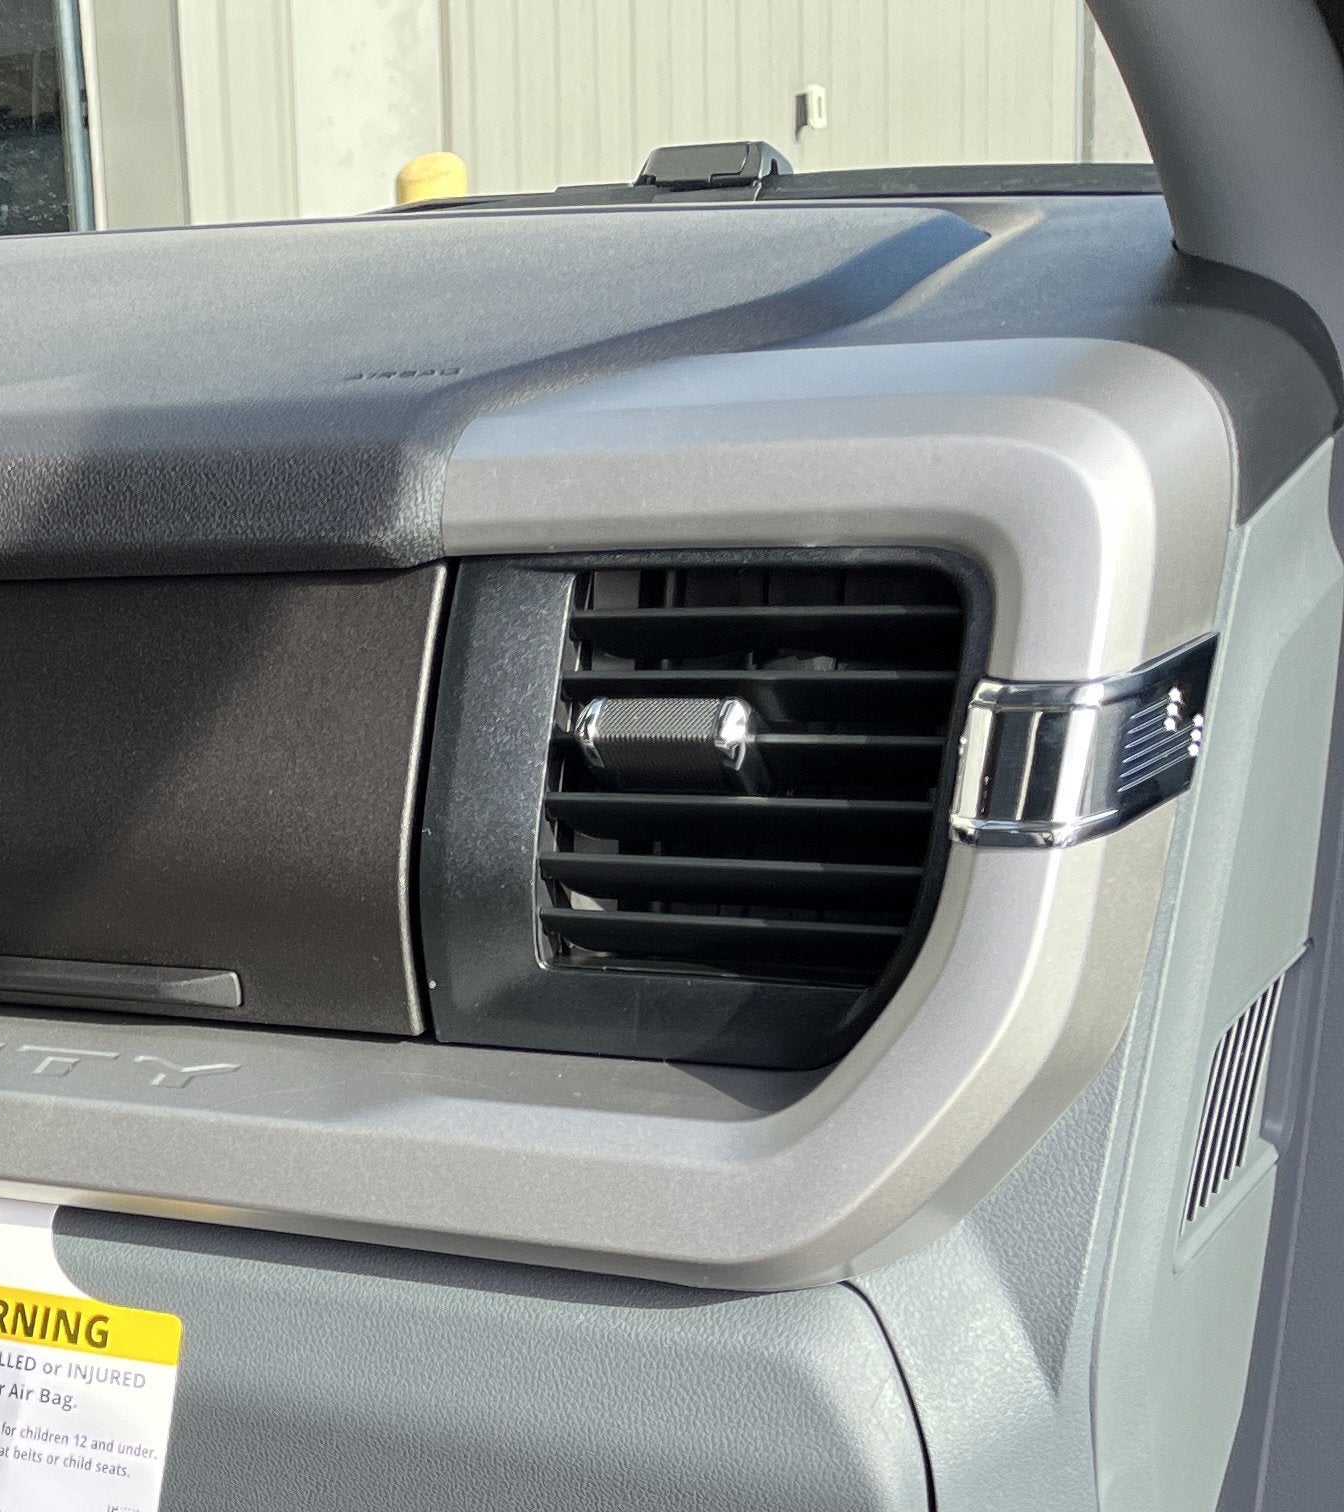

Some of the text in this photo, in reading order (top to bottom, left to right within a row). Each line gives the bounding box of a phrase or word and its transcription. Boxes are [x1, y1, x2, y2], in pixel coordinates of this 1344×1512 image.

[42, 1362, 62, 1376] or
[67, 1362, 146, 1389] INJURED
[8, 1383, 34, 1401] Air
[39, 1388, 79, 1412] Bag.
[1, 1421, 17, 1437] for
[19, 1425, 69, 1446] children
[73, 1433, 88, 1449] 12
[90, 1439, 114, 1453] and
[117, 1442, 159, 1461] under.
[13, 1446, 43, 1465] belts
[46, 1454, 60, 1466] or
[62, 1453, 93, 1471] child
[95, 1460, 132, 1478] seats.
